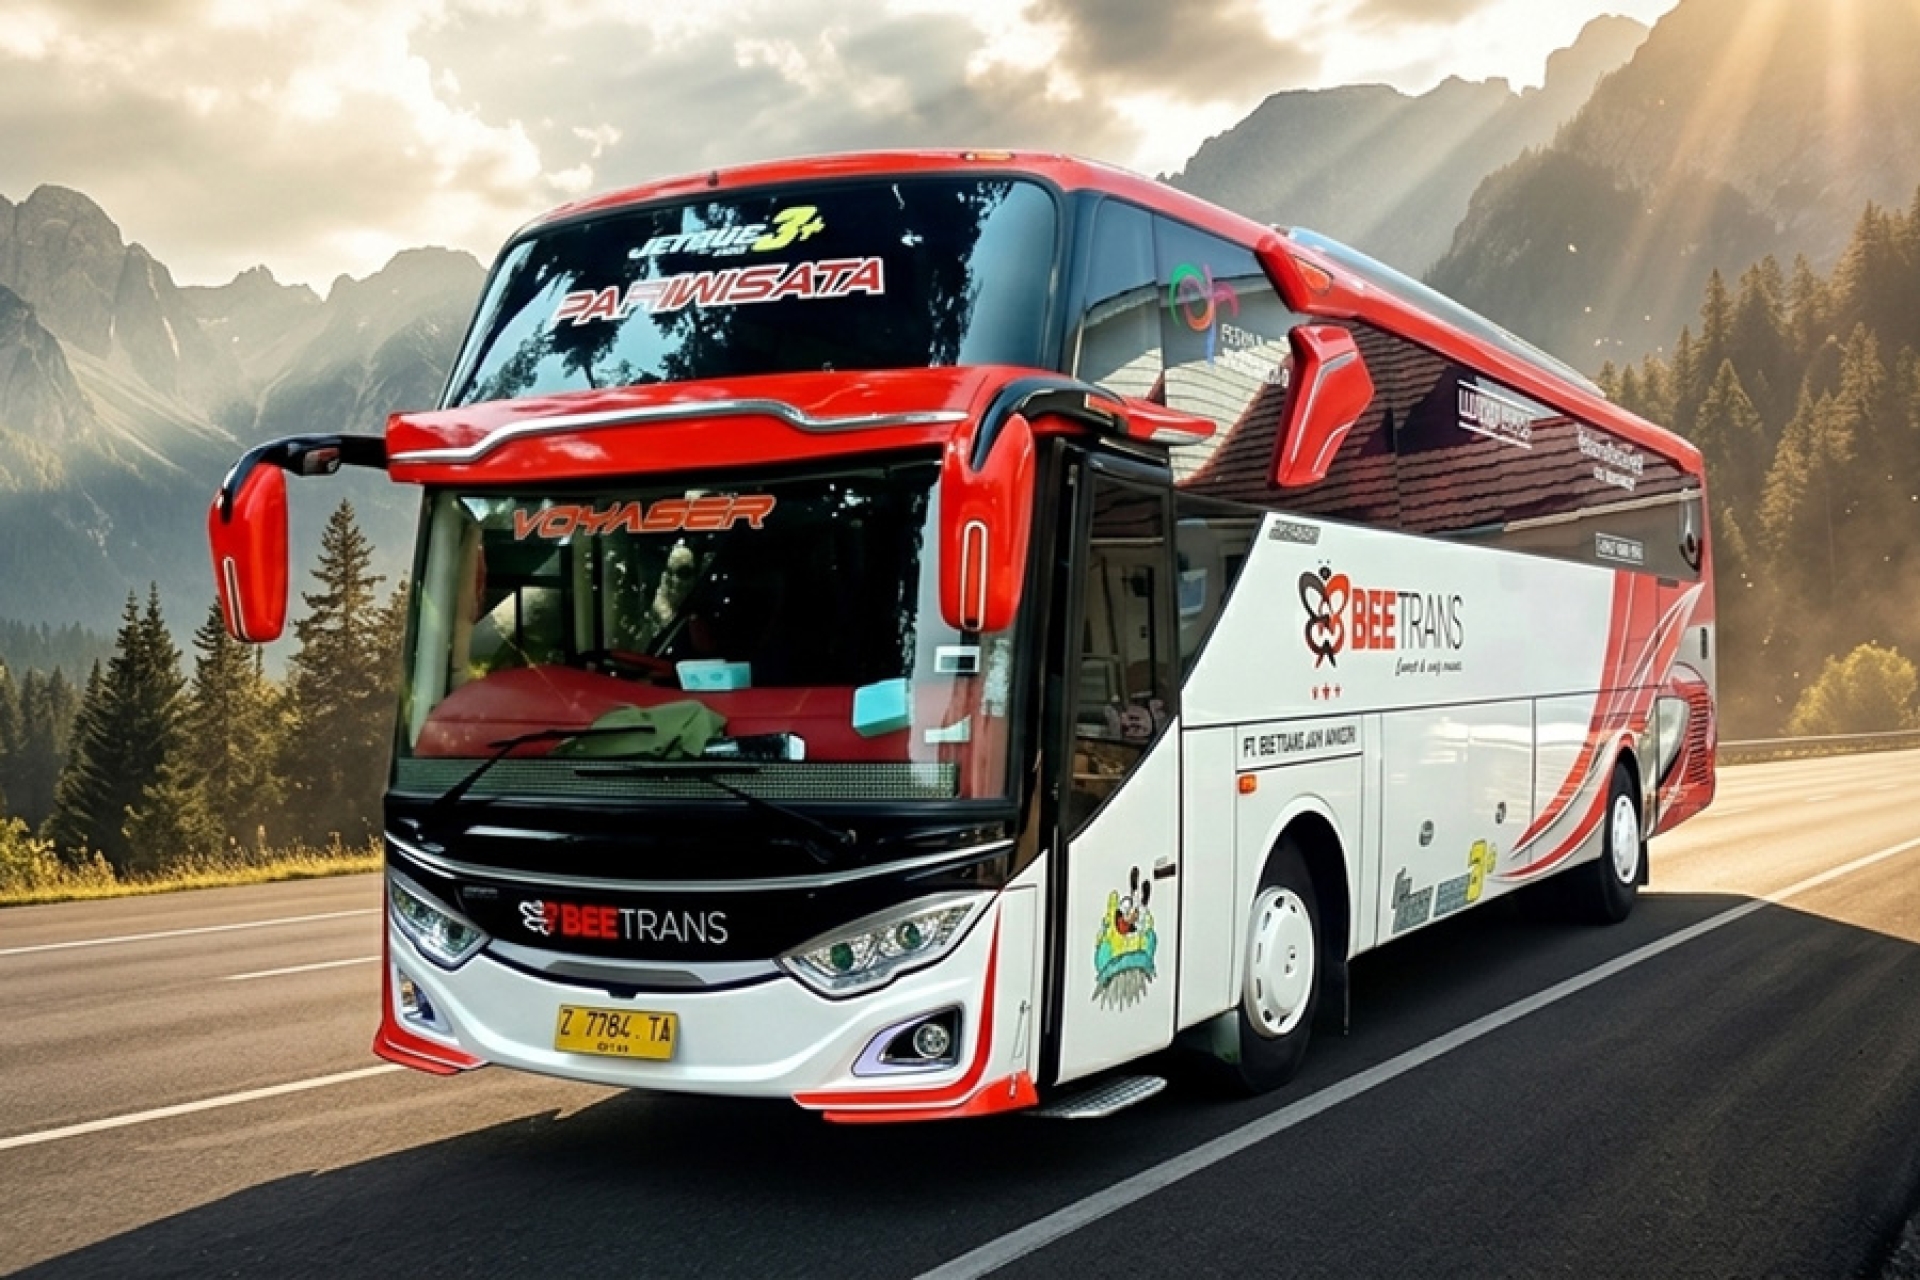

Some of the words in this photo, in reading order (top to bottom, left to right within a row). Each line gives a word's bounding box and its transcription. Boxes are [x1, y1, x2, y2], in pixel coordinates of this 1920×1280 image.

[750, 205, 825, 251] 3+
[1352, 588, 1463, 650] BEETRANS
[561, 903, 729, 944] BEETRANS
[560, 1008, 574, 1036] Z
[648, 1015, 671, 1041] TA
